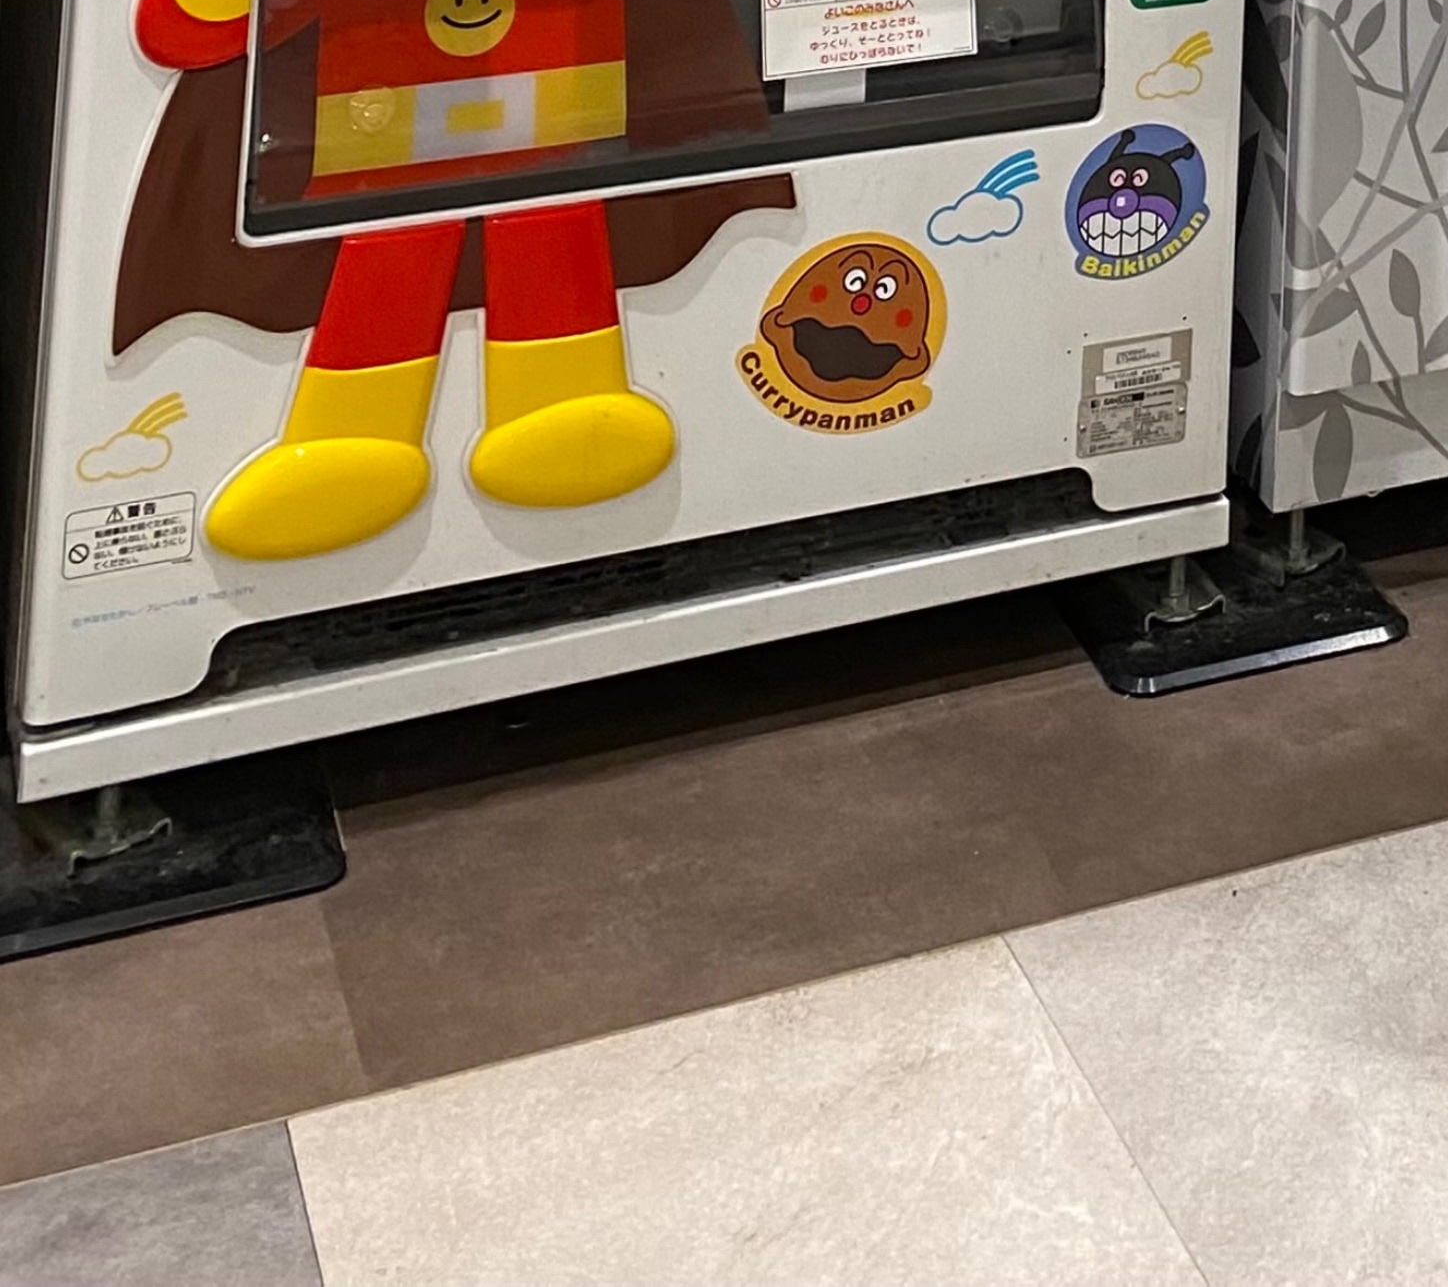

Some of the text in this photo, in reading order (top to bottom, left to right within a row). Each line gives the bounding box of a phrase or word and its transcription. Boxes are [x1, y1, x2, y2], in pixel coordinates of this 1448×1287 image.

[825, 0, 914, 19] よいこのみなさんへ
[1080, 210, 1206, 277] Baikinman
[740, 351, 915, 430] Currypanman
